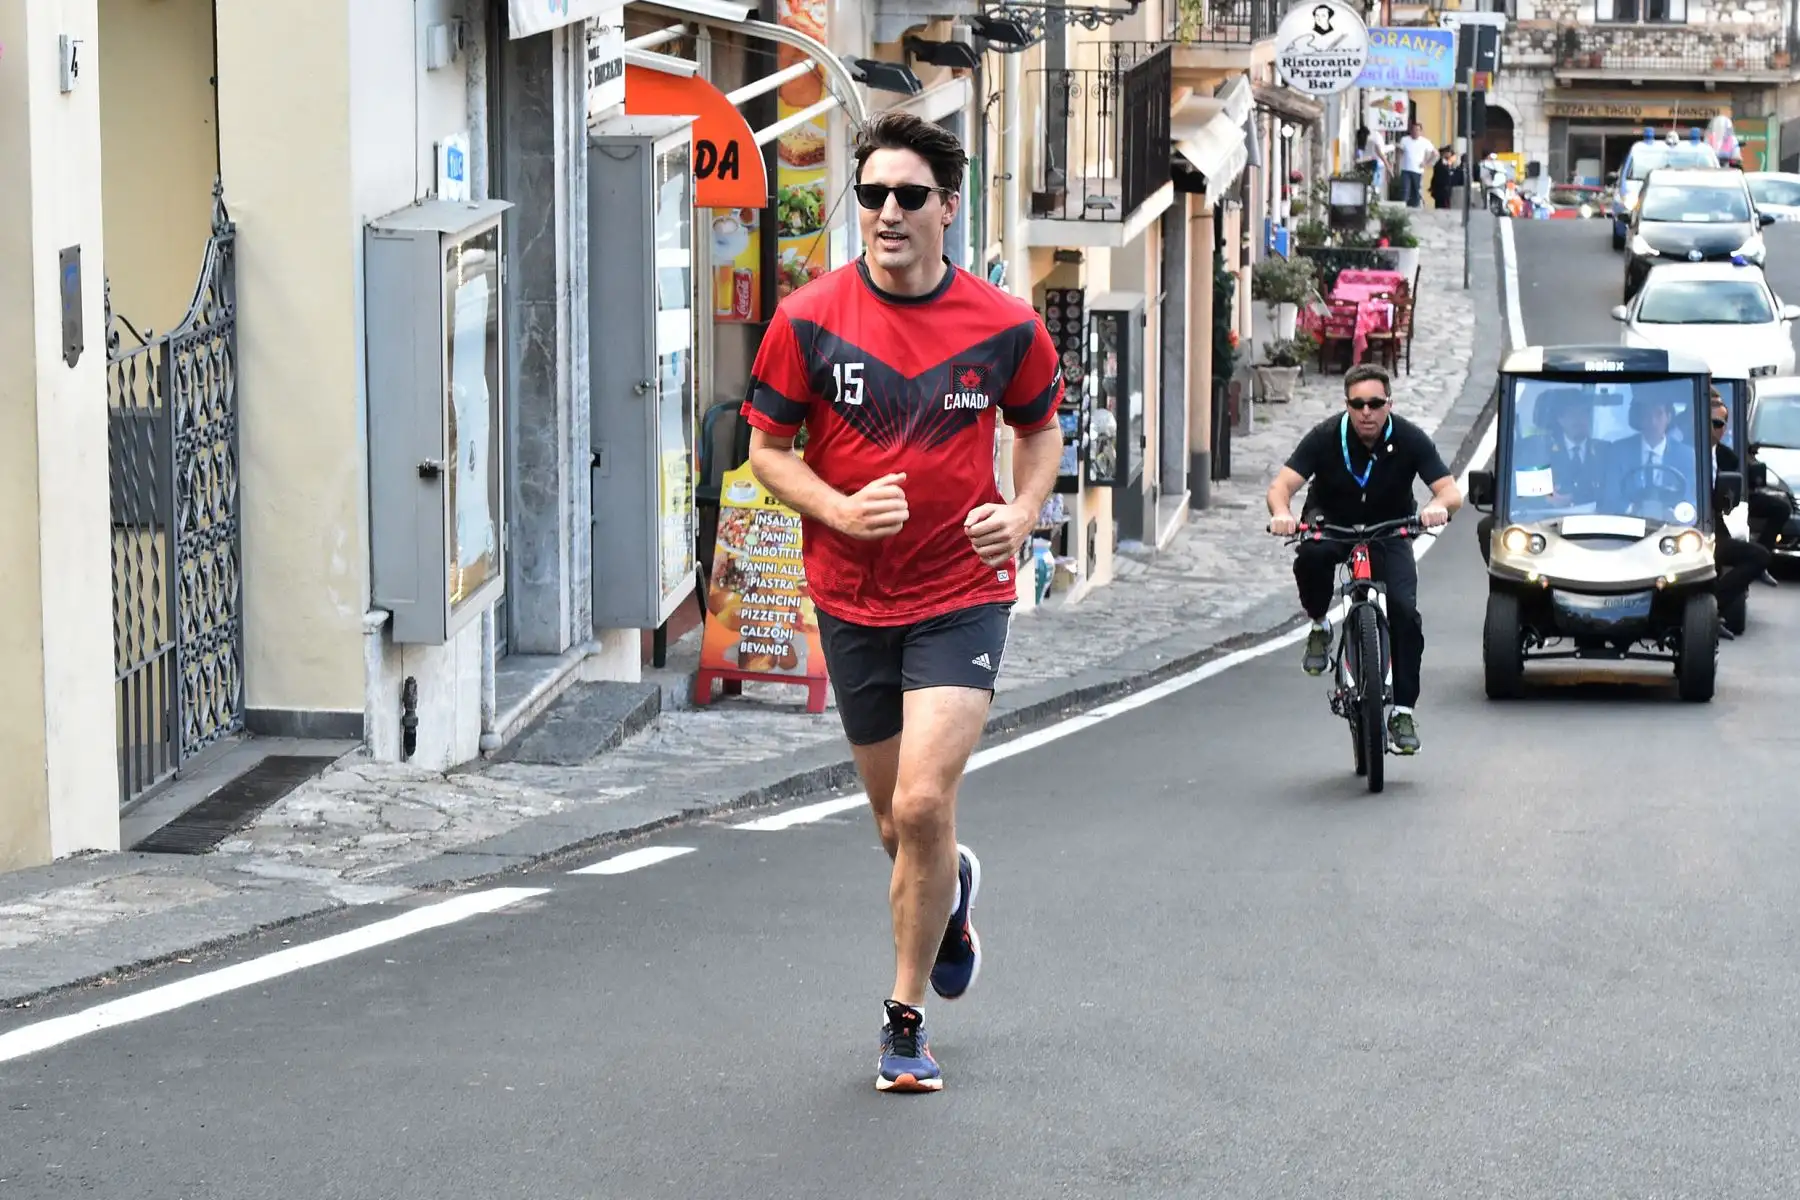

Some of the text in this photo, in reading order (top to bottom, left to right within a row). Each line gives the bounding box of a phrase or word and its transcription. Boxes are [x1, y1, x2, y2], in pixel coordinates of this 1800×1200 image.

[1370, 31, 1447, 60] ORANTE
[1282, 57, 1361, 68] Ristorante
[1290, 68, 1352, 78] Pizzeria
[1308, 80, 1336, 89] Bar
[1555, 106, 1585, 116] PIZZA
[1604, 107, 1642, 117] TAGLIO
[1668, 107, 1720, 117] ARANCINI
[1379, 119, 1404, 128] PIZZA
[833, 363, 865, 405] 15
[944, 393, 989, 410] CANADA
[760, 531, 797, 545] PANINI
[741, 561, 805, 576] PANINI ALLA
[750, 577, 794, 590] PIASTRA
[742, 593, 801, 608] ARANCINI
[740, 608, 797, 624] PIZZETTE
[740, 625, 794, 640] CALZONI
[740, 641, 789, 656] BEVANDE
[972, 659, 992, 670] adidas
